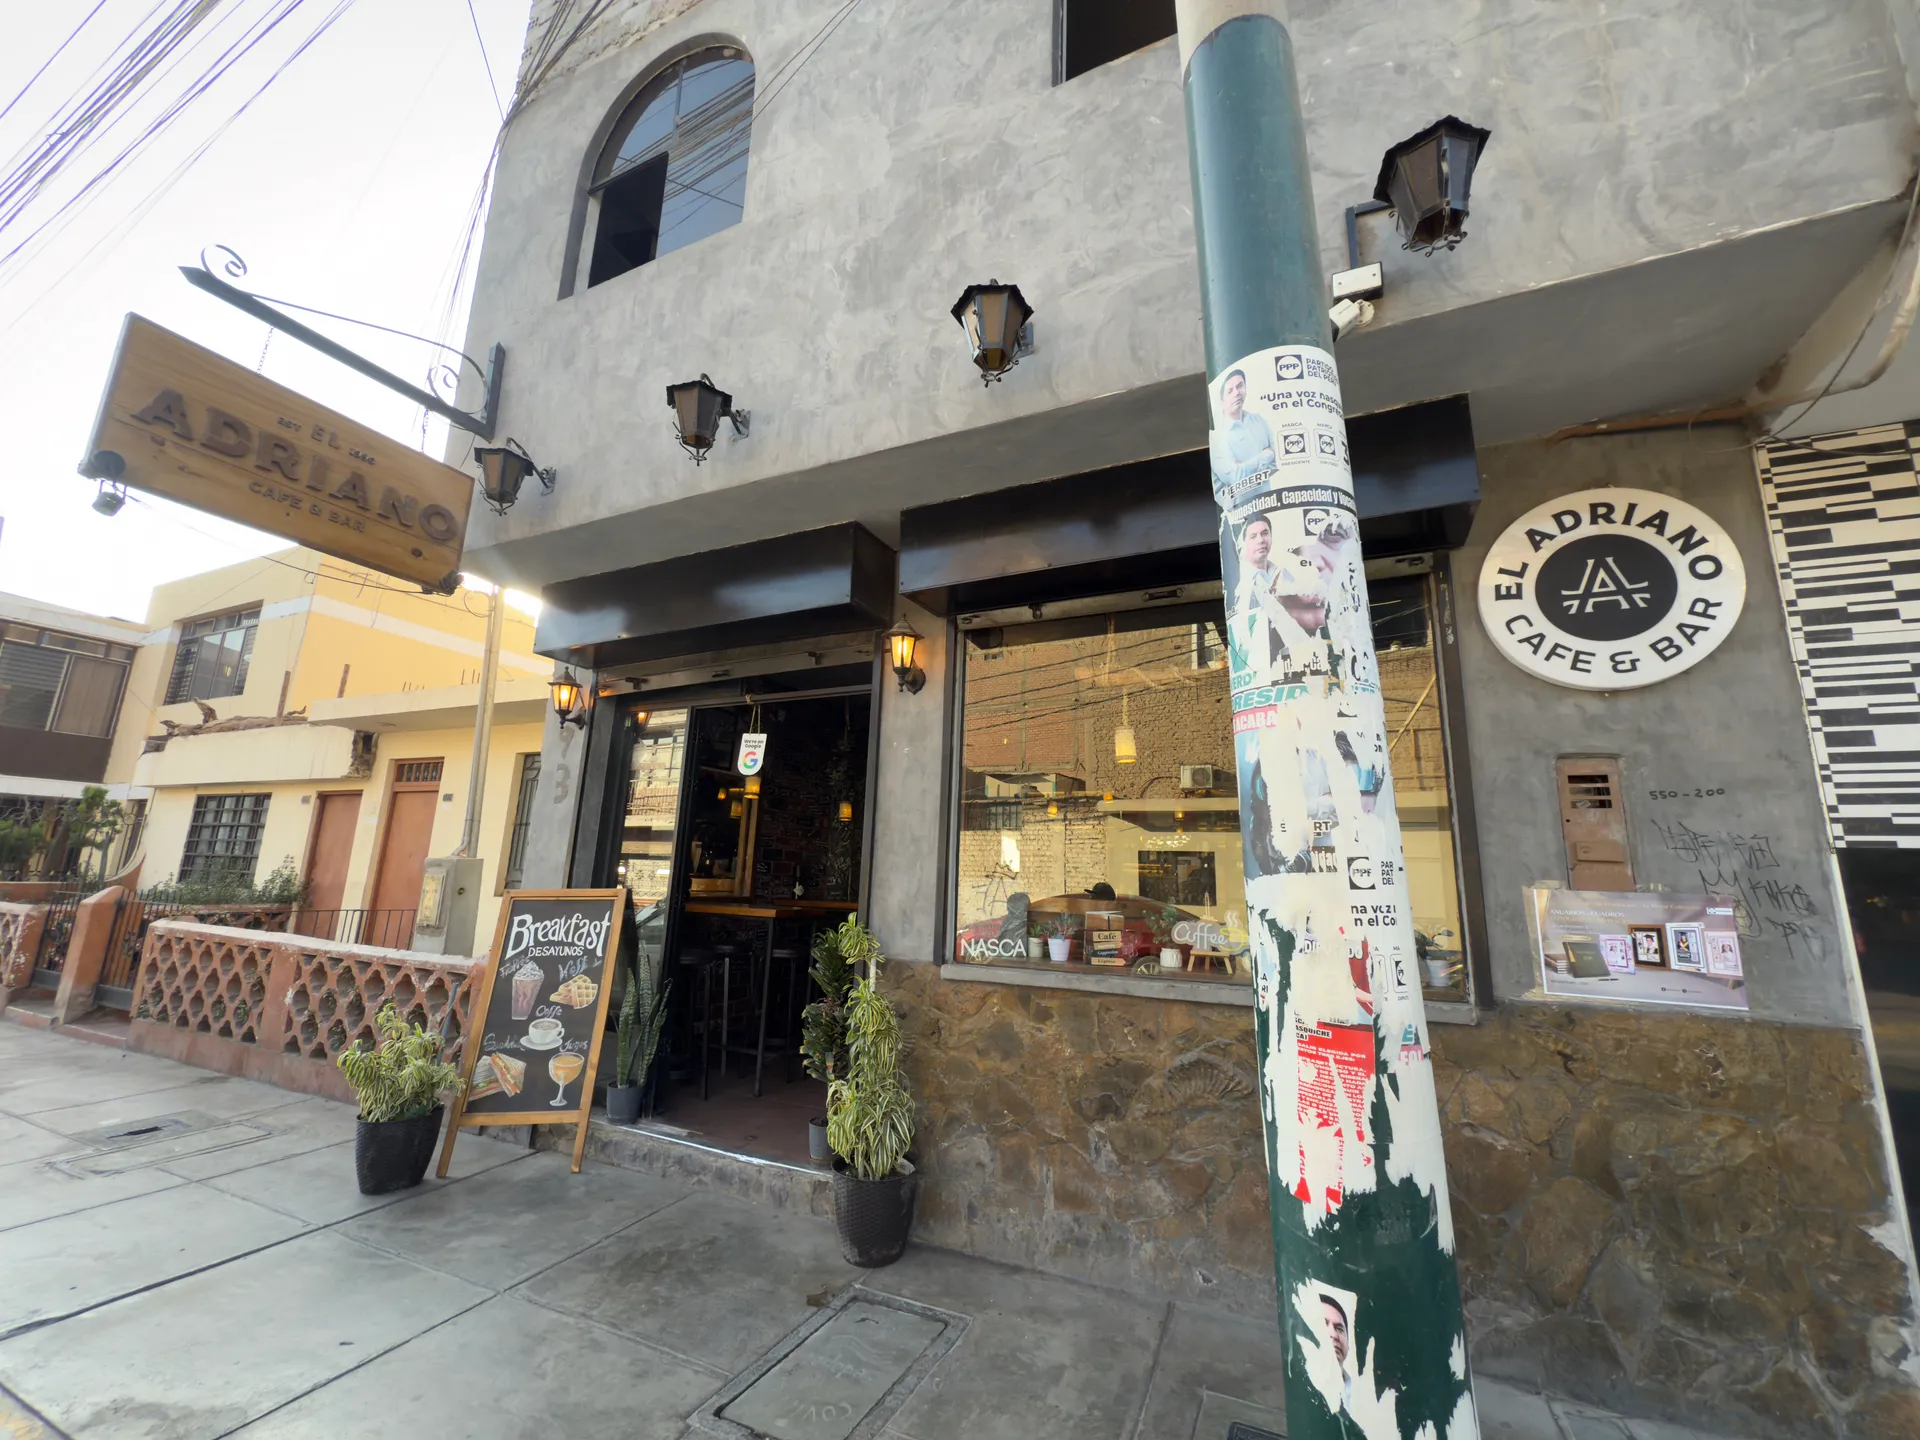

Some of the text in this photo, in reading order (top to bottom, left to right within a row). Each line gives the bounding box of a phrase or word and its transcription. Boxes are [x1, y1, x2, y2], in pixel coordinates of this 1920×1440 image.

[1279, 362, 1300, 371] PPP
[1272, 401, 1288, 410] en
[1292, 399, 1303, 407] el
[311, 424, 340, 449] EL
[130, 388, 459, 541] ADRIANO
[249, 482, 302, 510] CAFE
[328, 512, 365, 533] BAR
[1282, 489, 1332, 504] Capacidad
[1495, 502, 1723, 601] EL ADRIANO
[1505, 597, 1723, 674] CAFE & BAR
[505, 911, 611, 960] Breakfast
[960, 938, 1027, 957] NASCA
[1173, 921, 1228, 949] Coffee
[528, 946, 584, 957] DESAYUNOS
[1318, 1048, 1348, 1056] ELEGIDA
